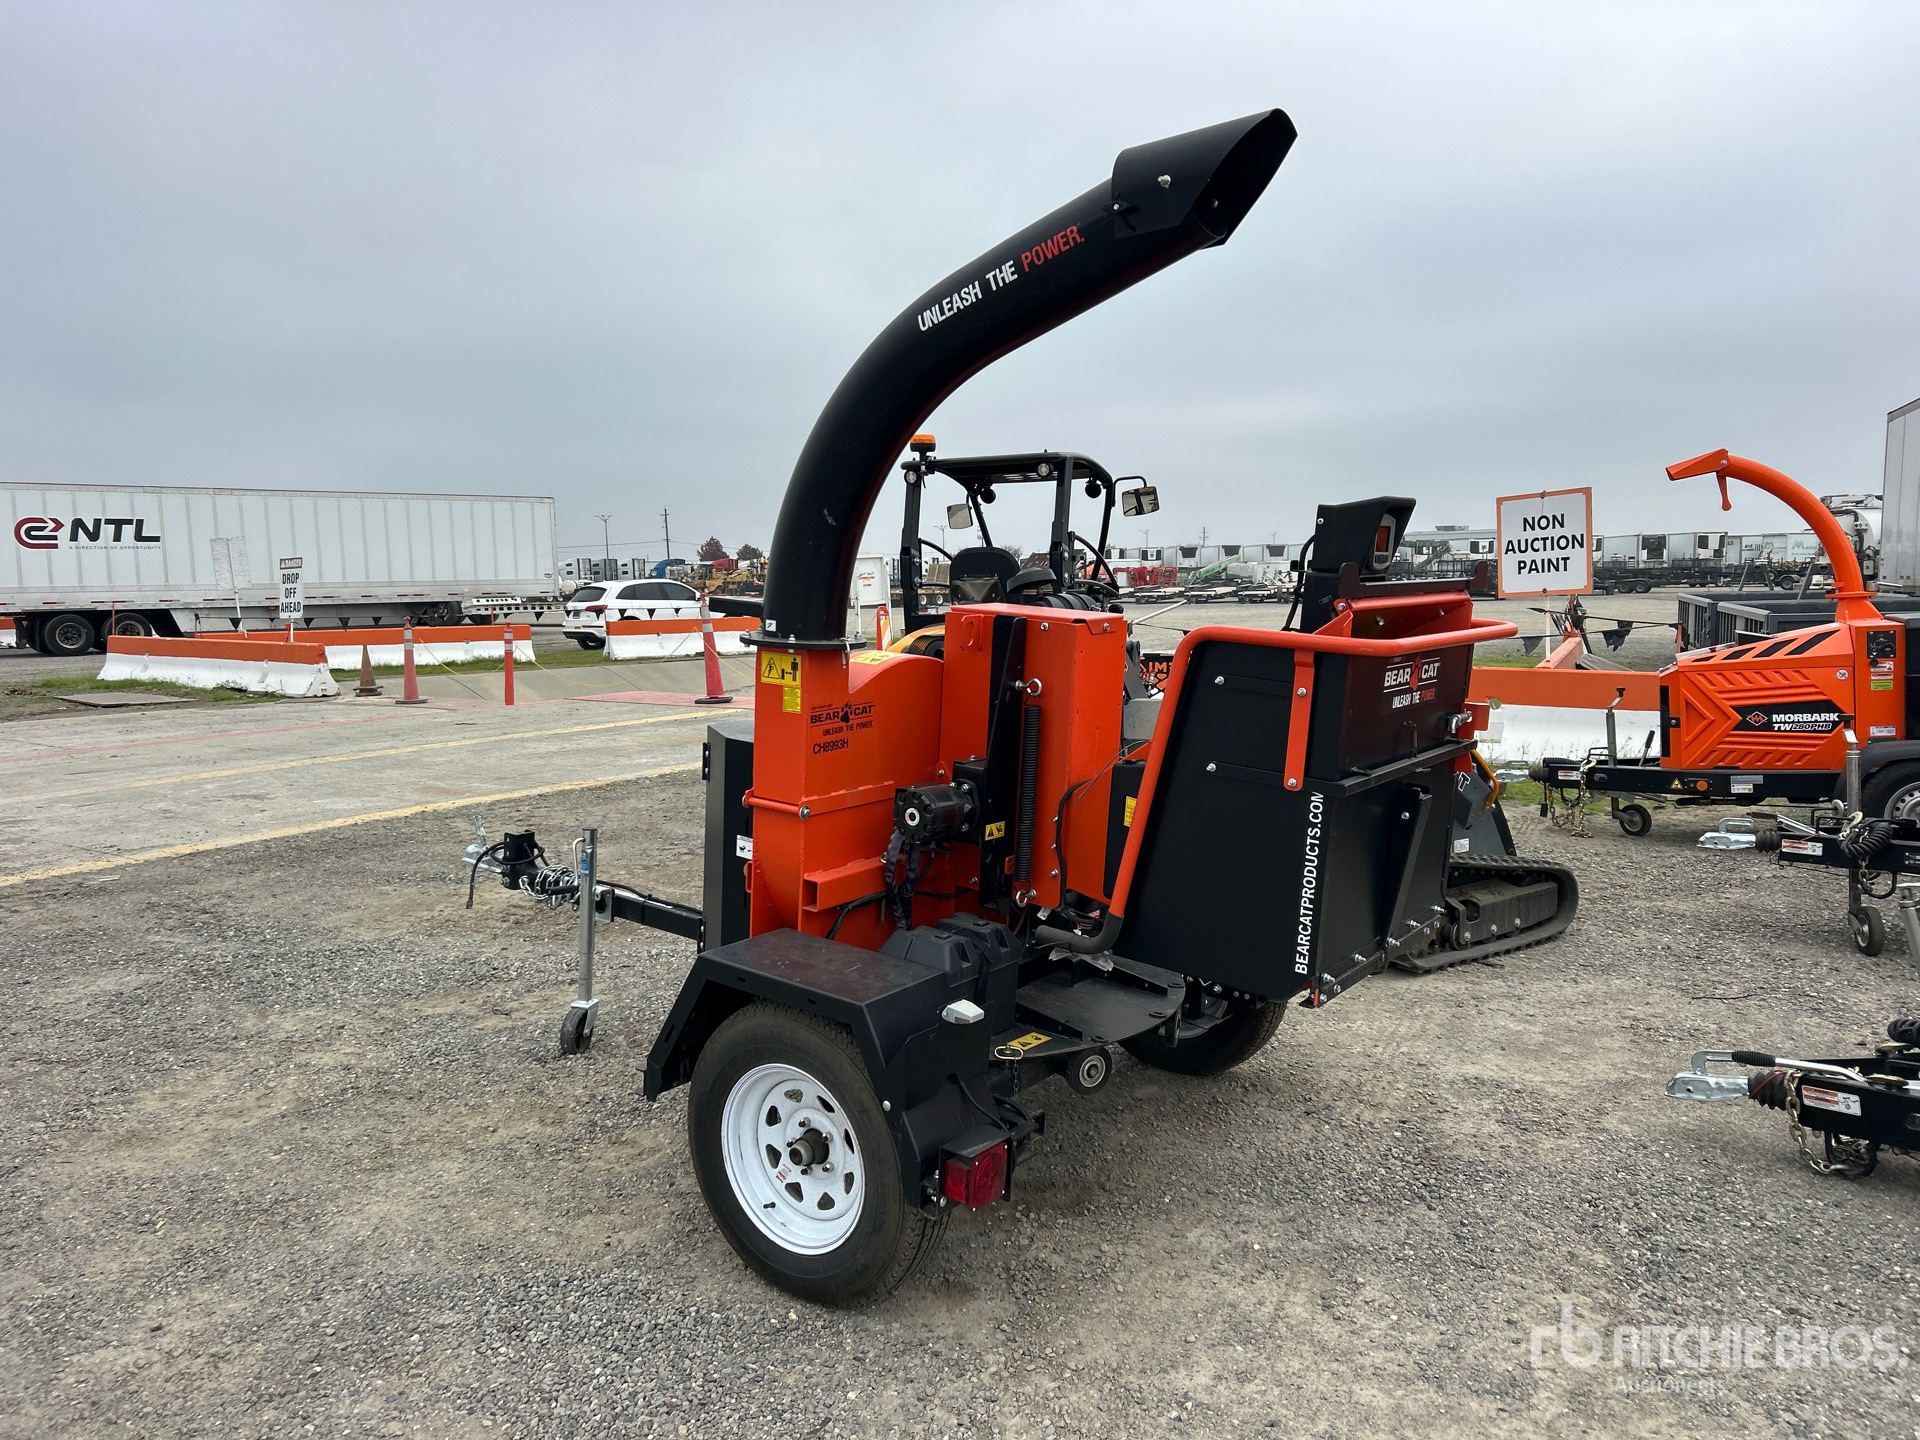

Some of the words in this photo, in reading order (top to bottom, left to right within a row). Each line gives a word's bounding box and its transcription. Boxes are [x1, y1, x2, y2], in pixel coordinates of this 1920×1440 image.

[917, 281, 983, 332] UNLEASH
[985, 260, 1018, 292] THE
[69, 518, 161, 543] NTL
[1522, 513, 1565, 532] NON
[1504, 533, 1585, 555] AUCTION
[1517, 556, 1571, 575] PAINT
[282, 572, 299, 584] DROP
[284, 587, 297, 599] OFF
[280, 602, 302, 613] AHEAD
[1384, 667, 1411, 687] BEAR
[1421, 662, 1440, 679] CAT
[810, 711, 840, 724] BEAR
[853, 705, 874, 717] CAT
[1772, 712, 1840, 723] MORBARK
[823, 726, 844, 737] UNLEASH
[846, 723, 855, 732] THE
[813, 738, 849, 755] CH8993H
